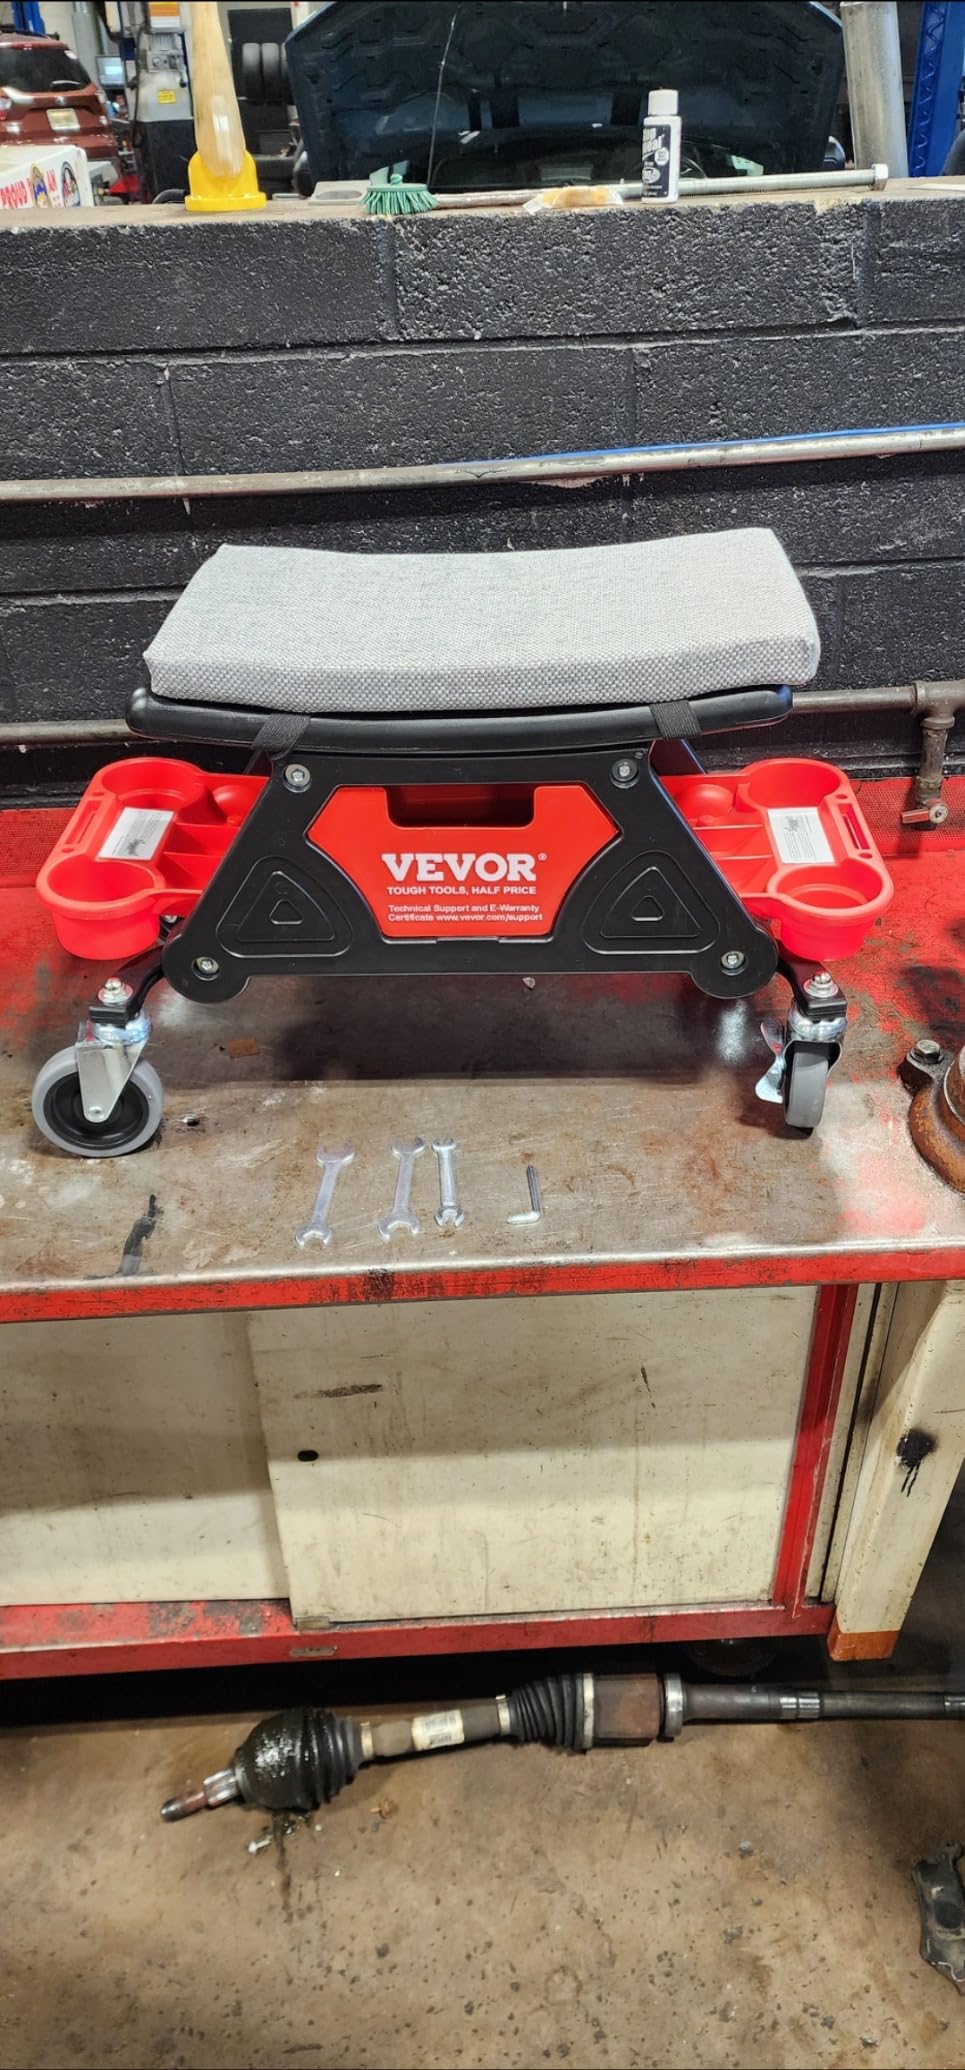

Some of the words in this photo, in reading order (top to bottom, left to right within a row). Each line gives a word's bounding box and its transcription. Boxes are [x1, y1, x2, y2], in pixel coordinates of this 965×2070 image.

[386, 886, 427, 895] TOUGH
[428, 886, 469, 896] TOOLS,
[471, 886, 501, 895] HALF
[503, 886, 537, 895] PRICE
[388, 904, 432, 912] Technical
[433, 904, 470, 914] Support
[470, 904, 488, 912] and
[489, 904, 541, 914] E-Warranty
[388, 913, 434, 922] Certificate
[435, 913, 543, 923] www.vevor.com/support
